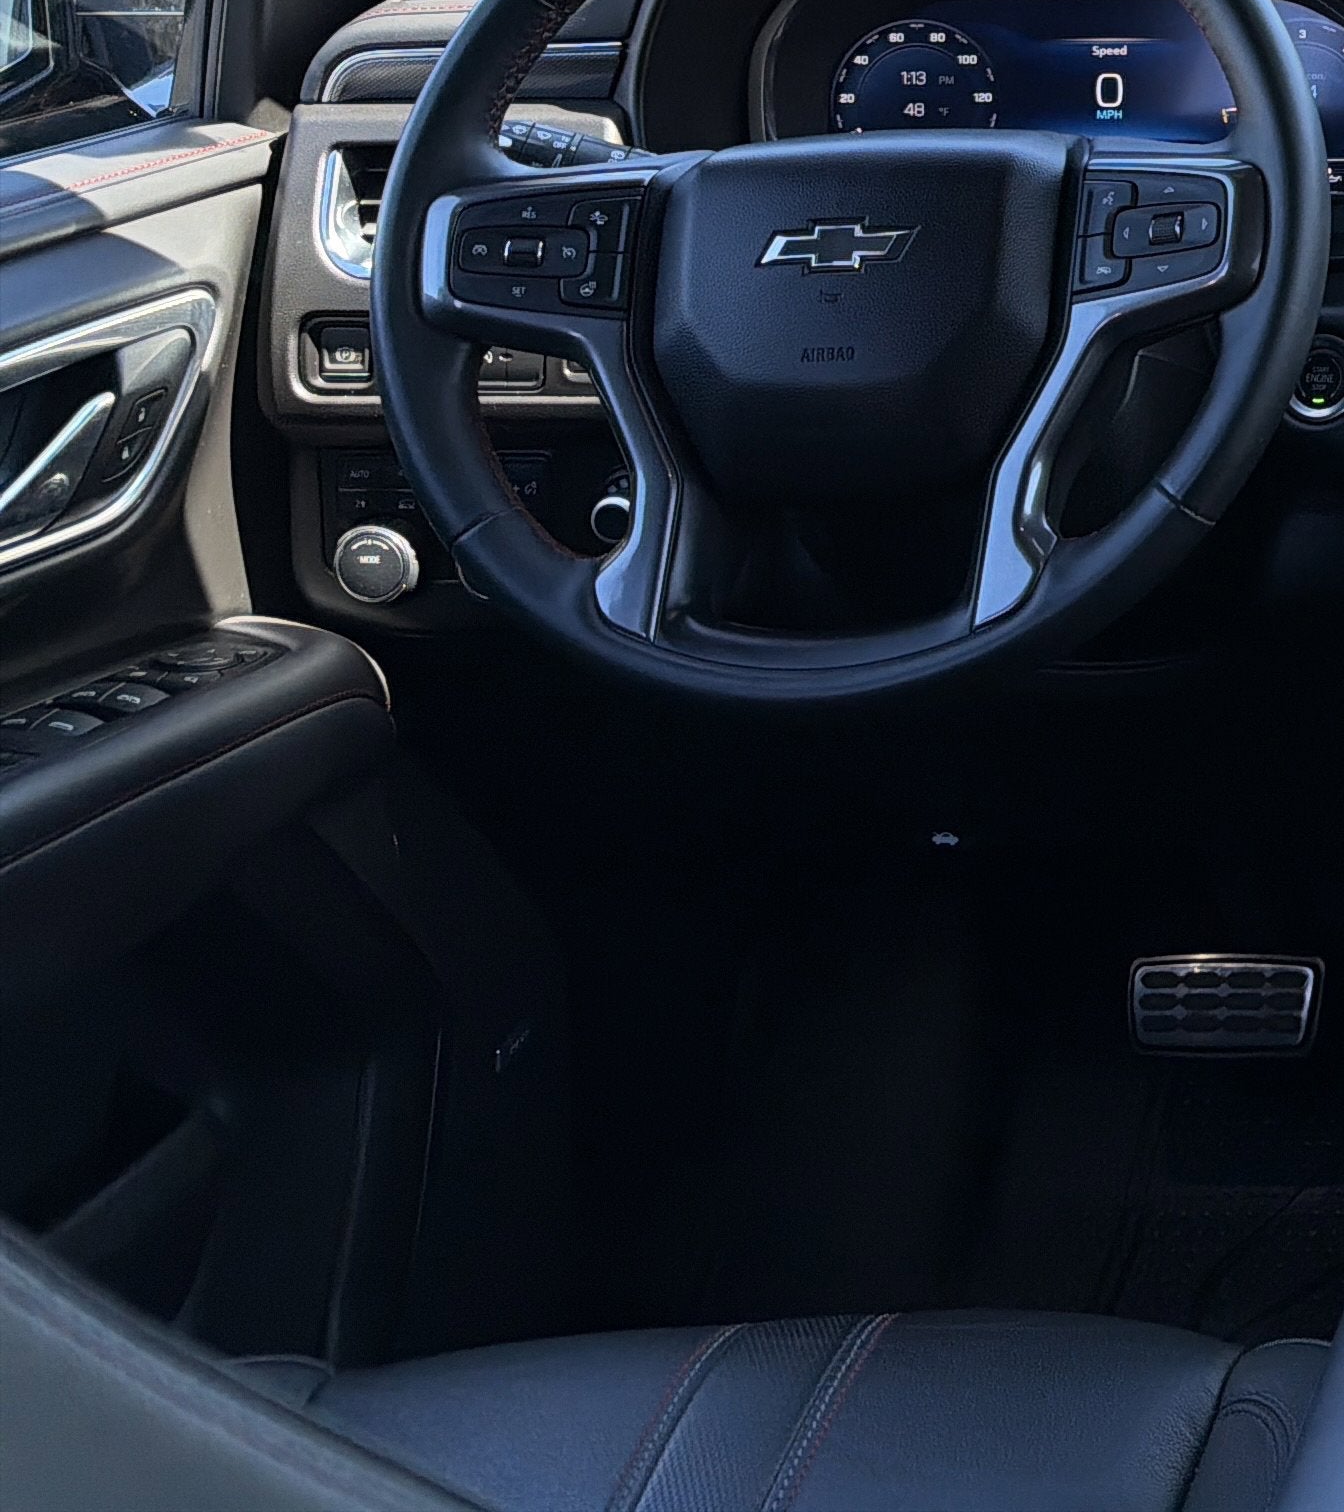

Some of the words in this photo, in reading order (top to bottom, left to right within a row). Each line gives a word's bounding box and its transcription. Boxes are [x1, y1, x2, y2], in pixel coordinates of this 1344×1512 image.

[888, 33, 905, 43] 60
[929, 33, 946, 43] 80
[1298, 29, 1307, 39] 3
[1091, 44, 1128, 59] Speed
[853, 55, 869, 65] 40
[956, 55, 978, 65] 100
[901, 70, 927, 86] 1:13
[939, 76, 955, 85] PM
[1095, 73, 1124, 108] 0
[839, 93, 855, 104] 20
[972, 92, 993, 103] 120
[902, 103, 925, 118] 48
[1096, 109, 1123, 120] MPH
[521, 211, 537, 219] RES
[511, 286, 527, 294] SET
[1305, 373, 1335, 384] ENGINE
[349, 470, 370, 479] AUTO
[359, 555, 382, 565] MODE
